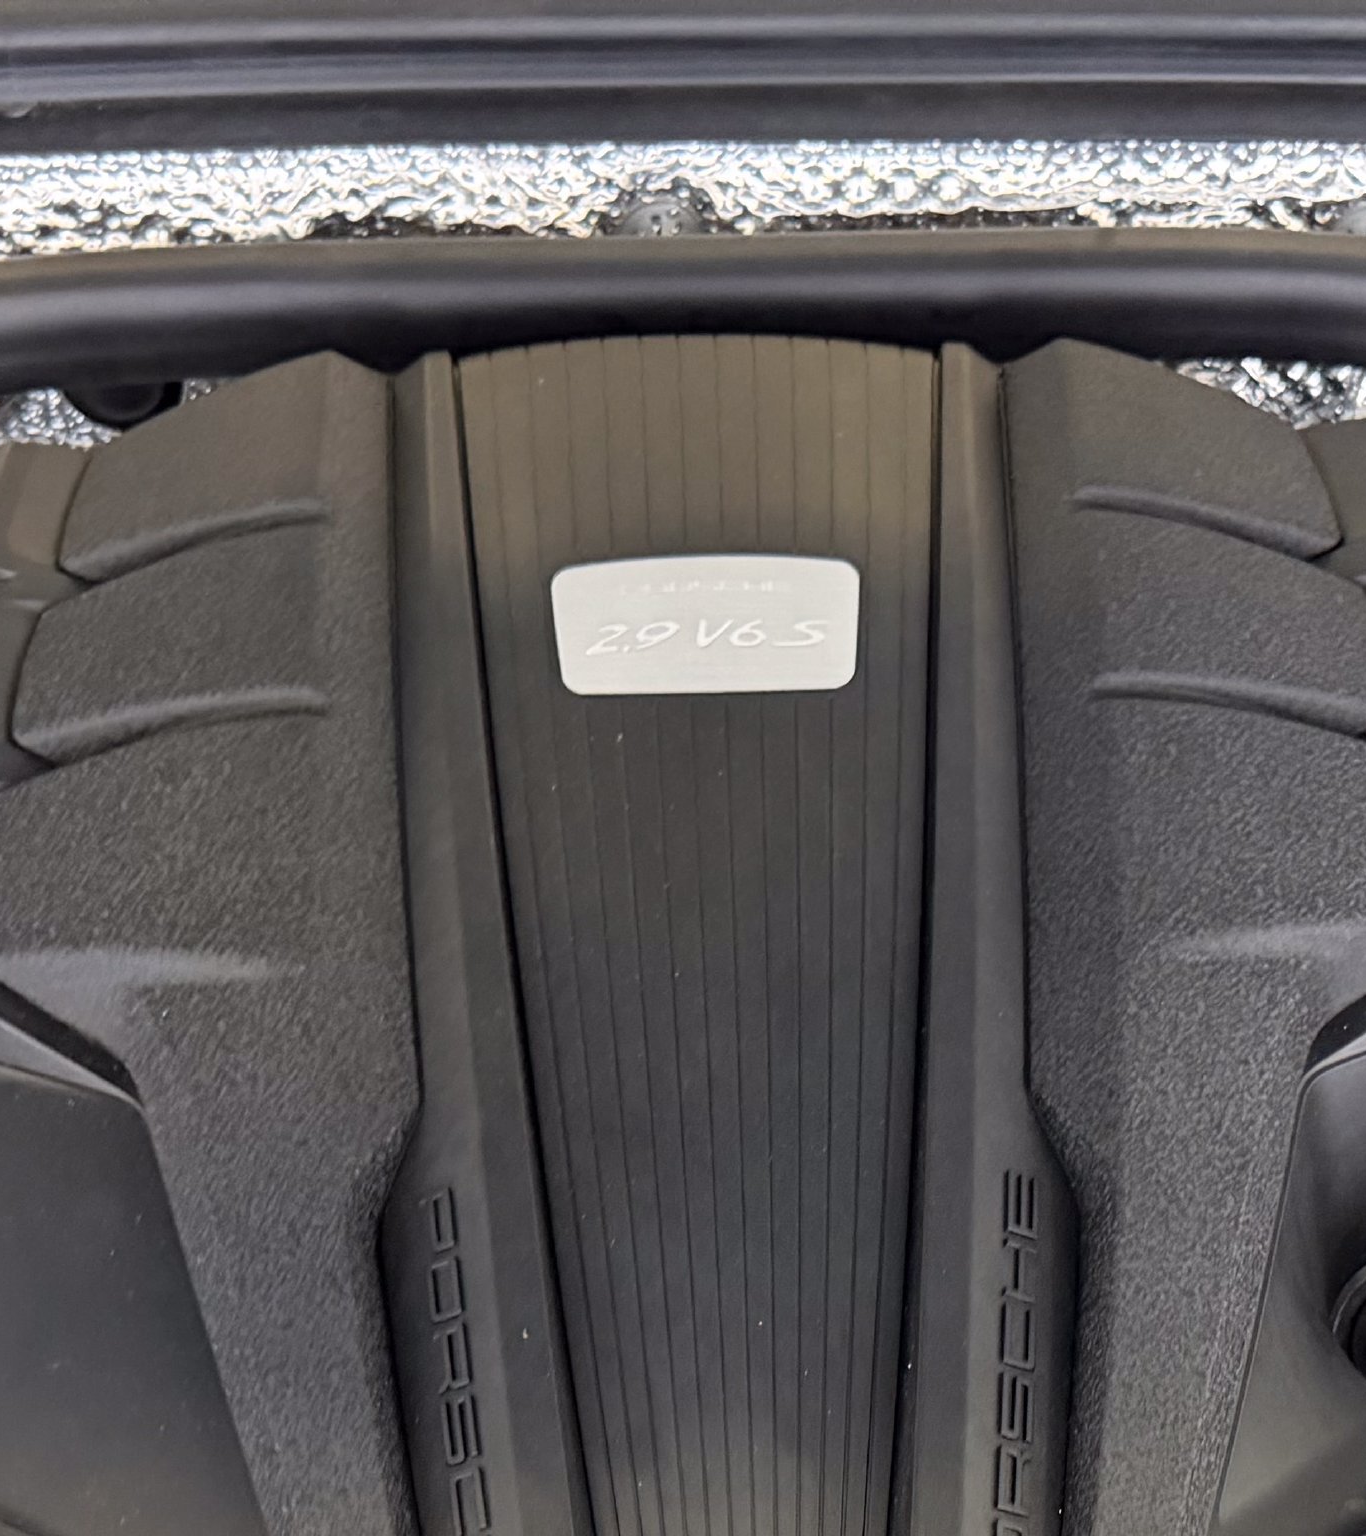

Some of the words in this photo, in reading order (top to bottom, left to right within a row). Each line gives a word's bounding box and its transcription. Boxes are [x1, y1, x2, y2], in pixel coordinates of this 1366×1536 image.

[585, 620, 680, 656] 2.9
[696, 619, 768, 648] V6
[772, 619, 832, 647] S
